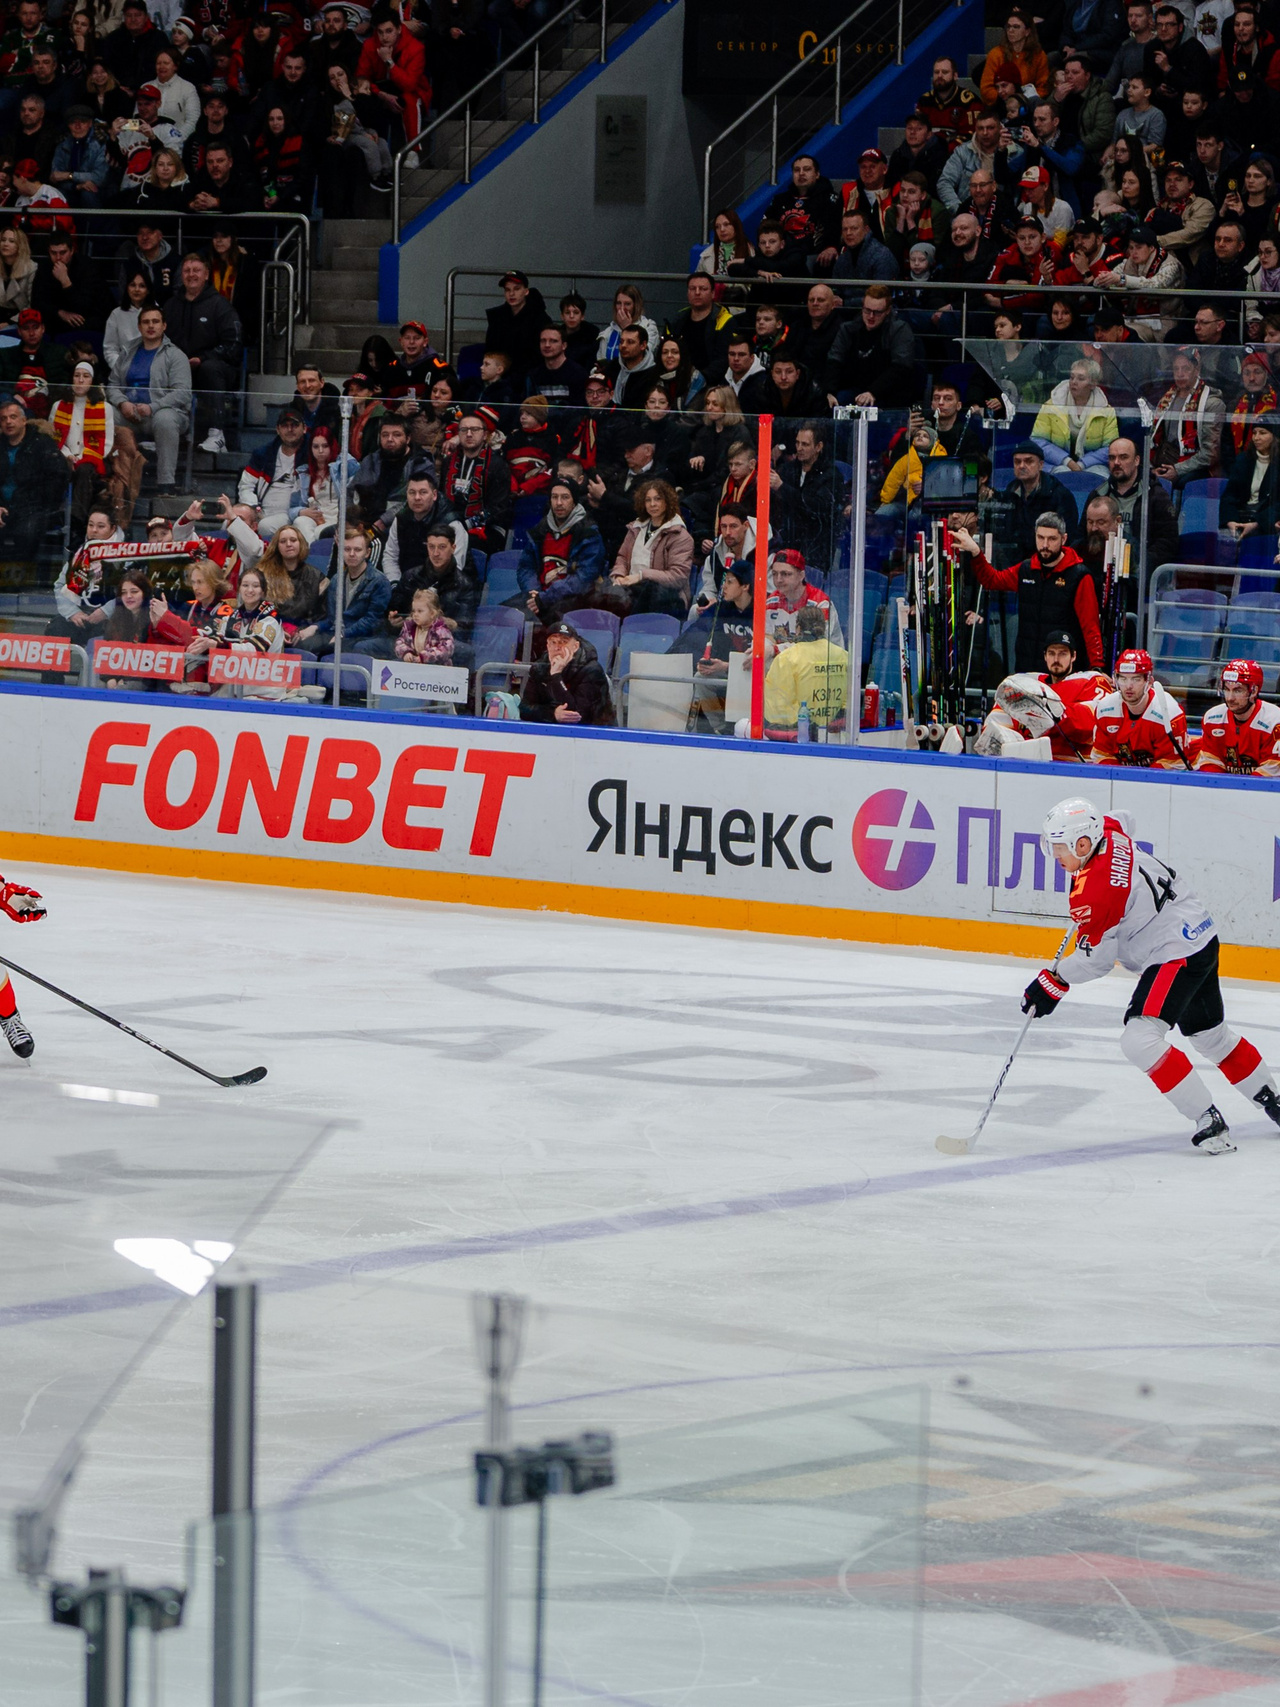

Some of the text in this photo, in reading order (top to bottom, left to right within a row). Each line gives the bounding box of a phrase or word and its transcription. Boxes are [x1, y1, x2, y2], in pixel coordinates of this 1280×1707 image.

[95, 645, 183, 675] FONBET
[209, 654, 300, 683] FONBET
[394, 677, 460, 697] Ростелеком
[74, 721, 536, 857] FONBET
[586, 779, 834, 876] Яндекс
